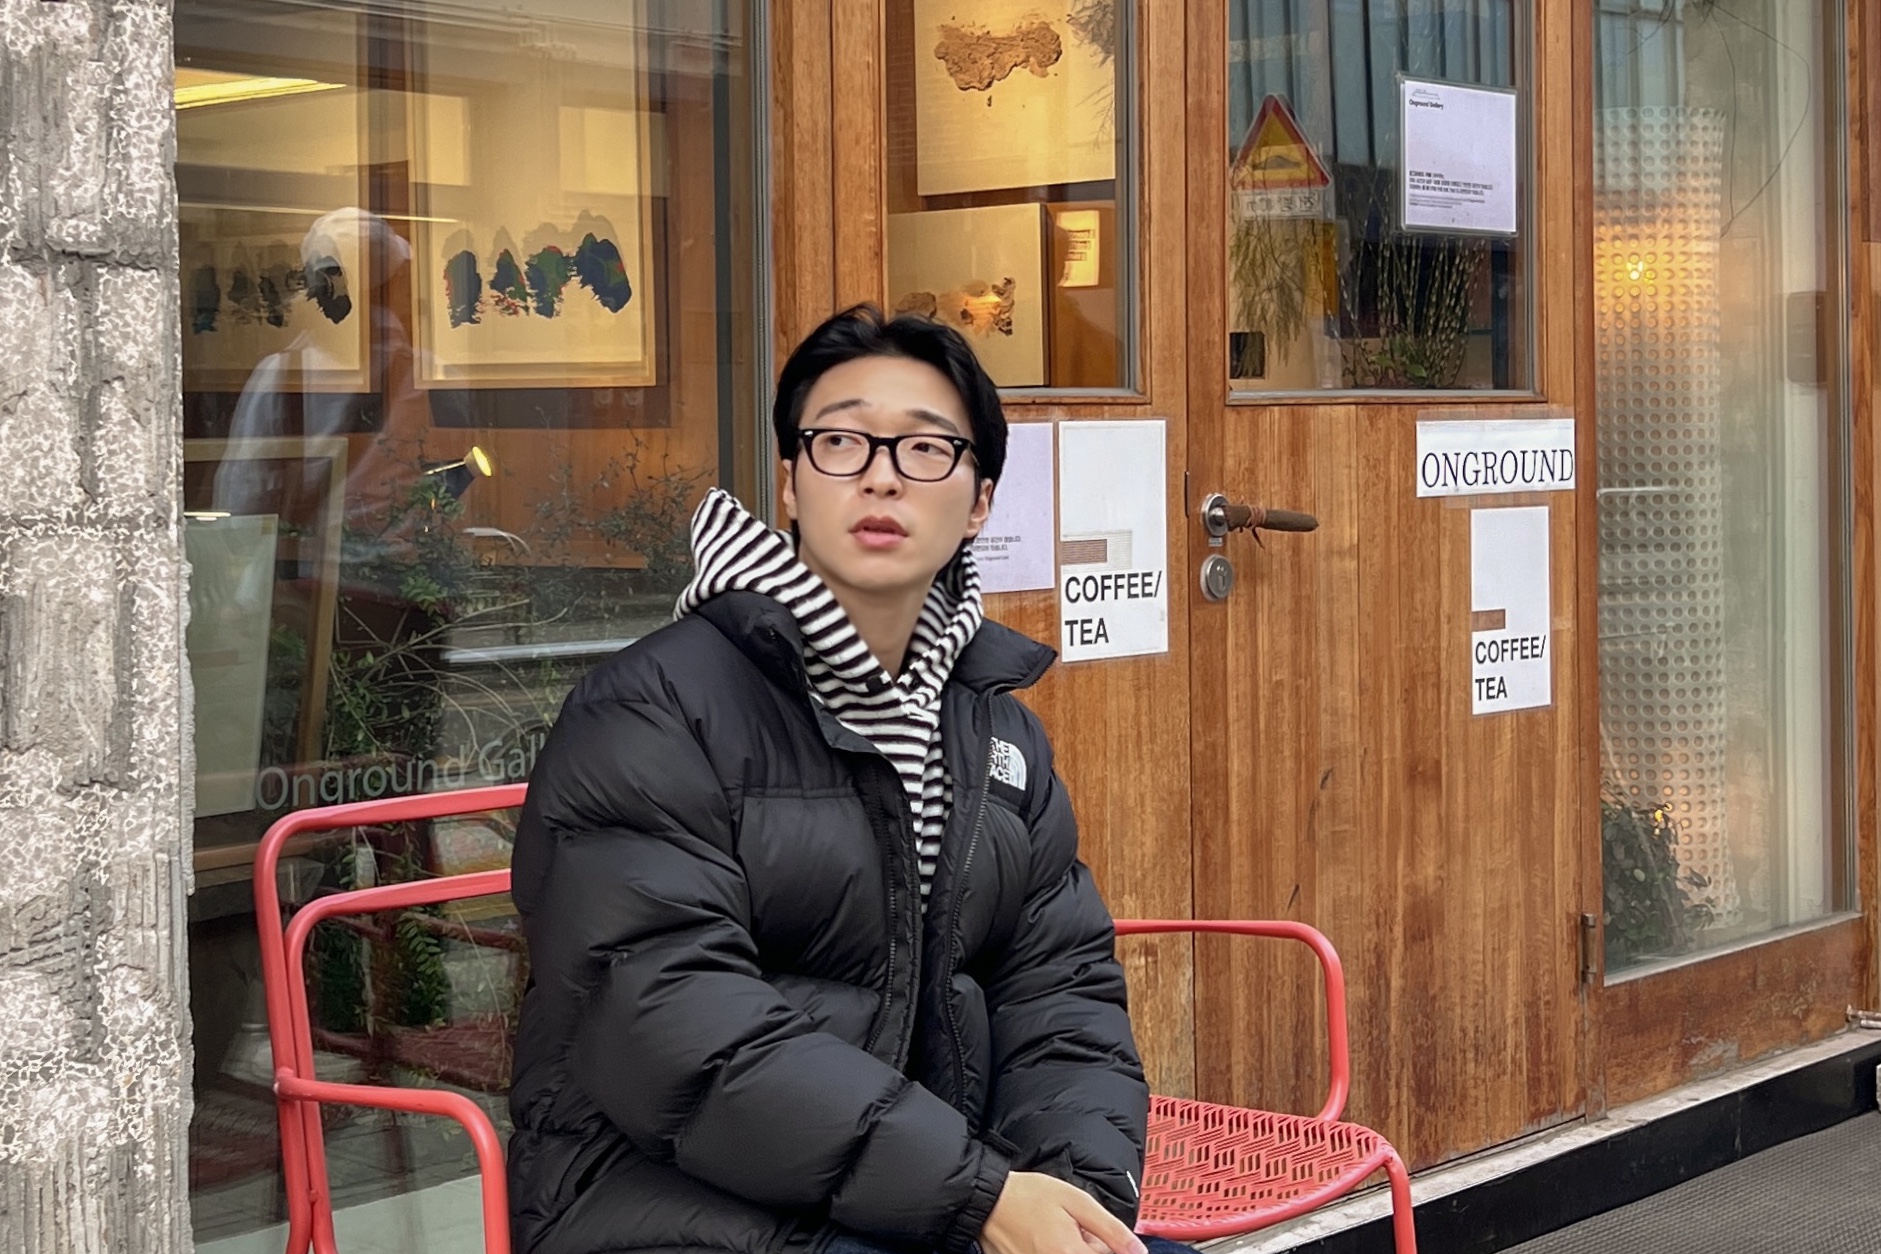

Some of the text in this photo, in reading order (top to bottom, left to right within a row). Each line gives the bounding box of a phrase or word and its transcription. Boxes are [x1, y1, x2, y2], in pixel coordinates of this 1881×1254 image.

[1421, 449, 1574, 488] ONGROUND
[1065, 570, 1162, 604] COFFEE/
[1064, 617, 1109, 647] TEA
[1475, 634, 1546, 665] COFFEE/
[1475, 676, 1508, 701] TEA
[255, 745, 466, 810] Onground
[989, 765, 1010, 784] ACE
